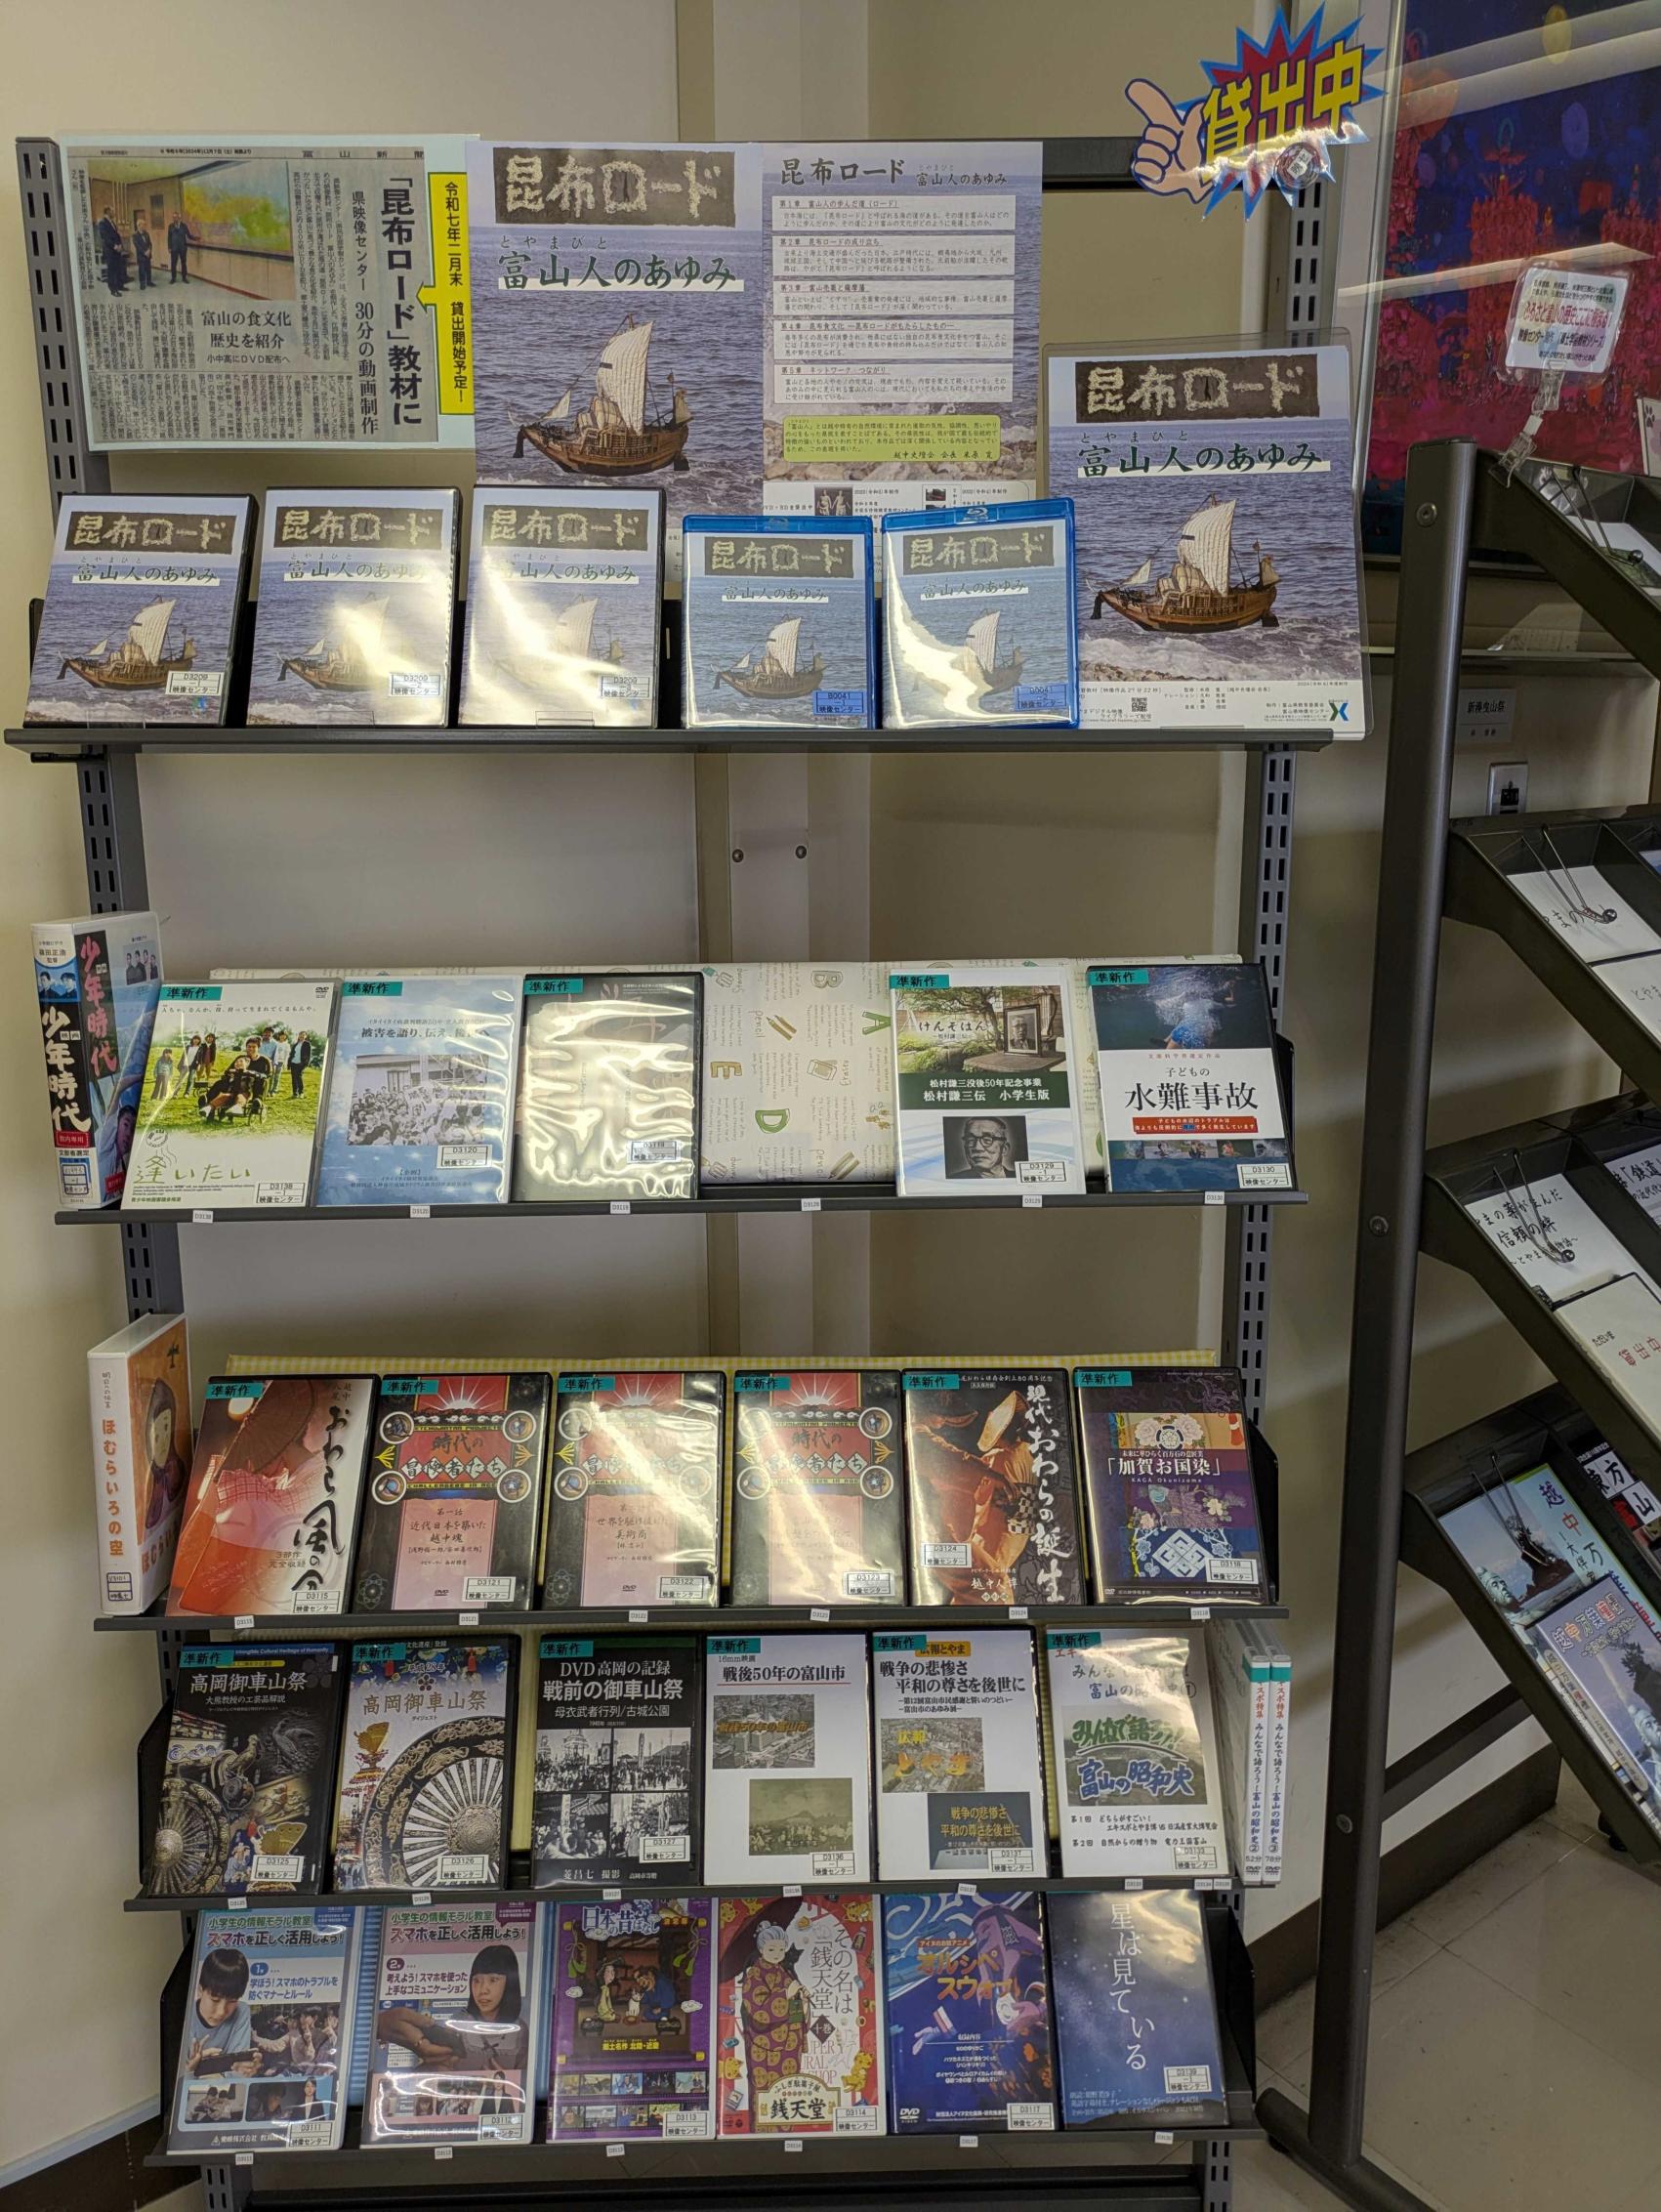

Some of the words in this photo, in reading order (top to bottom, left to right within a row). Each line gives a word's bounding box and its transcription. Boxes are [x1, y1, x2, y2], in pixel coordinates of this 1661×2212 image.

[1201, 39, 1365, 186] 貸出中
[781, 157, 905, 186] 昆布ロード
[916, 172, 1008, 187] 富山人のあゆみ
[506, 154, 722, 219] 昆布ロード
[352, 190, 368, 291] 県映像センター
[444, 181, 464, 287] 令和七年二月末
[498, 250, 736, 290] 富山人のあゆみ
[381, 177, 424, 426] 「昆布ロード」教材に
[200, 310, 292, 327] 富山の食文化
[210, 332, 284, 350] 歴史を紹介
[354, 301, 379, 435] 30分の動画制作
[1086, 361, 1305, 416] 昆布ロード
[1078, 441, 1322, 478] 富山人のあゆみ
[73, 515, 227, 550] 昆布ロード
[281, 509, 434, 546] 昆布ロード
[490, 508, 640, 547] 昆布ロード
[711, 540, 846, 573] 昆布ロード
[910, 531, 1045, 568] 昆布ロード
[77, 563, 218, 583] 富山人のあゆみ
[725, 585, 827, 601] 富山人のあゆみ
[923, 579, 1024, 599] 富山人のあゆみ
[172, 685, 217, 693] 映像センター
[394, 687, 438, 695] 映像センター
[896, 976, 936, 987] 準新作
[1095, 970, 1136, 983] 準新作
[166, 986, 208, 999] 準新作
[348, 982, 389, 994] 準新作
[529, 980, 570, 992] 準新作
[80, 935, 117, 1078] 少年時代
[41, 1005, 93, 1133] 少年時代
[1165, 1066, 1211, 1078] 子どもの
[923, 1090, 986, 1103] 松村謙三伝
[999, 1089, 1051, 1102] 小学生版
[1124, 1080, 1259, 1112] 水難事故
[133, 1154, 251, 1185] 逢いたい
[1245, 1177, 1287, 1186] 映像センター
[387, 1380, 426, 1393] 準新作
[564, 1377, 602, 1390] 準新作
[740, 1377, 779, 1389] 準新作
[908, 1375, 945, 1388] 準新作
[1081, 1372, 1119, 1385] 準新作
[211, 1383, 249, 1397] 準新作
[1107, 1457, 1222, 1477] 「加賀お国染」
[102, 1418, 124, 1557] ほむらいろの空
[1025, 1384, 1073, 1603] 現代おわらの誕生
[543, 1643, 581, 1654] 準新作
[711, 1639, 749, 1651] 準新作
[878, 1636, 915, 1649] 準新作
[1052, 1634, 1090, 1648] 準新作
[183, 1651, 221, 1665] 準新作
[355, 1647, 393, 1658] 準新作
[560, 1661, 596, 1677] DVD
[597, 1660, 672, 1676] 高岡の記録
[723, 1664, 846, 1683] 戦後50年の富山市
[879, 1660, 969, 1678] 戦争の悲惨さ
[189, 1671, 308, 1694] 高岡御車山祭
[542, 1678, 685, 1702] 戦前の御車山祭
[895, 1676, 1026, 1694] 平和の尊さを後世に
[362, 1690, 488, 1716] 高岡御車山祭
[1077, 1758, 1195, 1801] 富山の昭和史
[950, 1806, 1008, 1819] 戦争の悲惨さ
[940, 1823, 1021, 1837] 平和の尊さを後世に
[1177, 1860, 1215, 1869] 映像センター
[208, 1915, 313, 1930] 小学生の情報モラル教室
[391, 1910, 494, 1924] 小学生の情報モラル教室
[810, 1941, 833, 2018] 「銭天堂」
[834, 1928, 853, 2015] その名は
[1109, 1902, 1156, 2070] 星は見ている
[769, 2097, 827, 2120] 銭天堂
[899, 2108, 921, 2116] DVD
[668, 2127, 705, 2136] 映像センター
[838, 2122, 876, 2131] 映像センター
[1012, 2119, 1050, 2128] 映像センター
